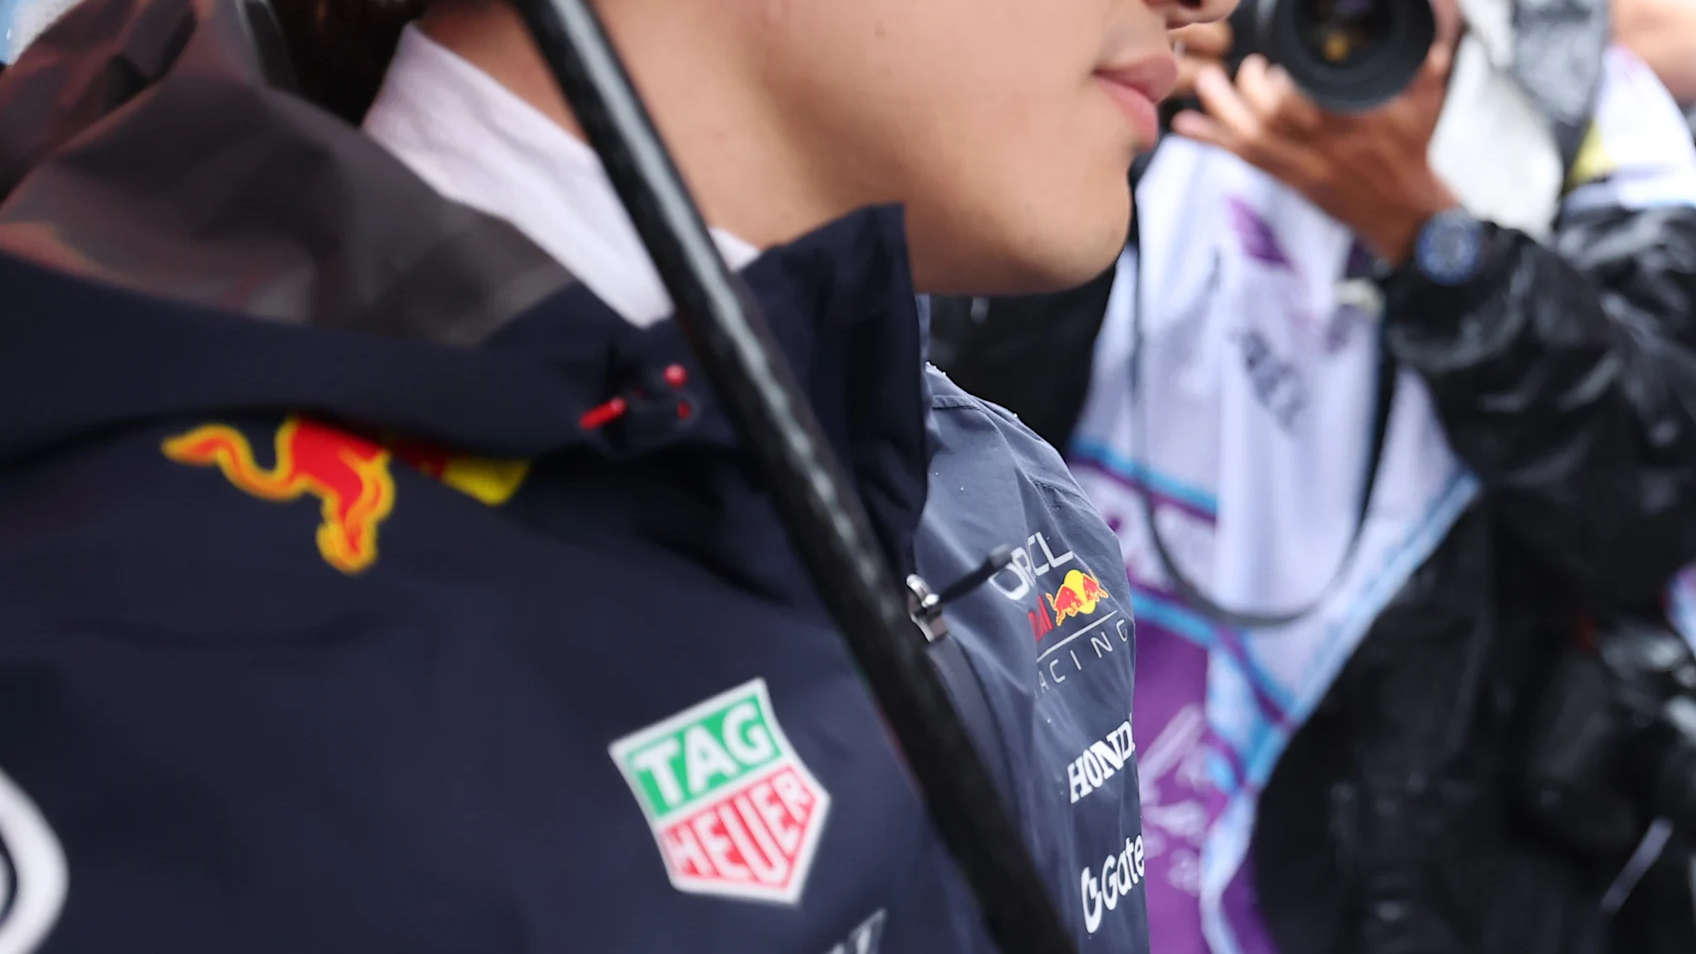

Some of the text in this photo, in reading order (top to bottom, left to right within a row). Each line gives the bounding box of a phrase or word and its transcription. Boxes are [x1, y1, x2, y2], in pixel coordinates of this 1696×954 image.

[631, 702, 775, 808] TAG
[1067, 715, 1136, 805] HOND
[664, 772, 810, 884] HEUER
